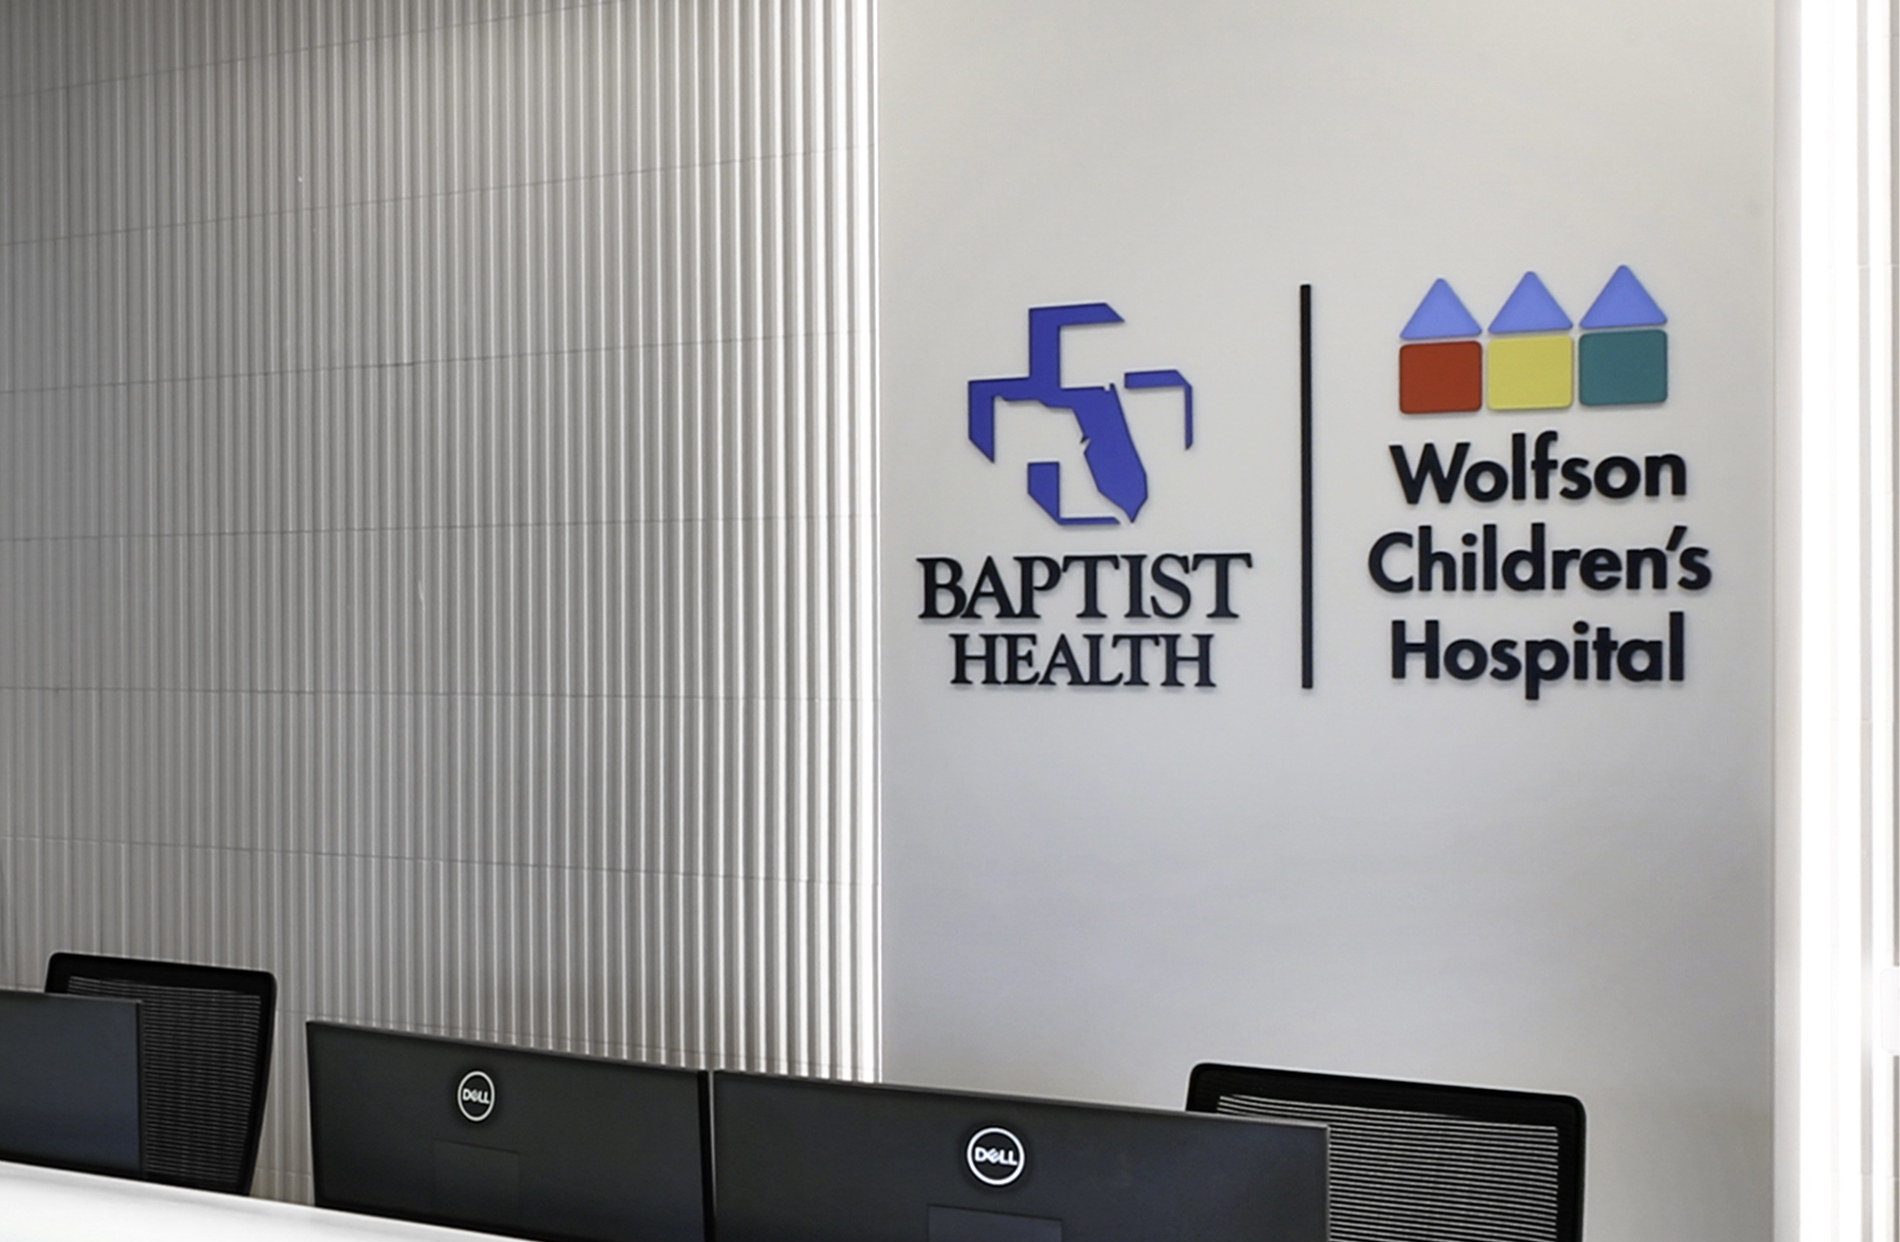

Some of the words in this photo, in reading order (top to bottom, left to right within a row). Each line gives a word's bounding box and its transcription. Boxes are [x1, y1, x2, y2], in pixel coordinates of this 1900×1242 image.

[1388, 430, 1688, 507] Wolfson
[915, 552, 1253, 622] BAPTIST
[1367, 522, 1713, 595] Children's
[948, 633, 1218, 690] HEALTH
[1390, 610, 1686, 702] Hospital
[462, 1088, 491, 1105] DELL
[974, 1146, 1018, 1166] DELL
